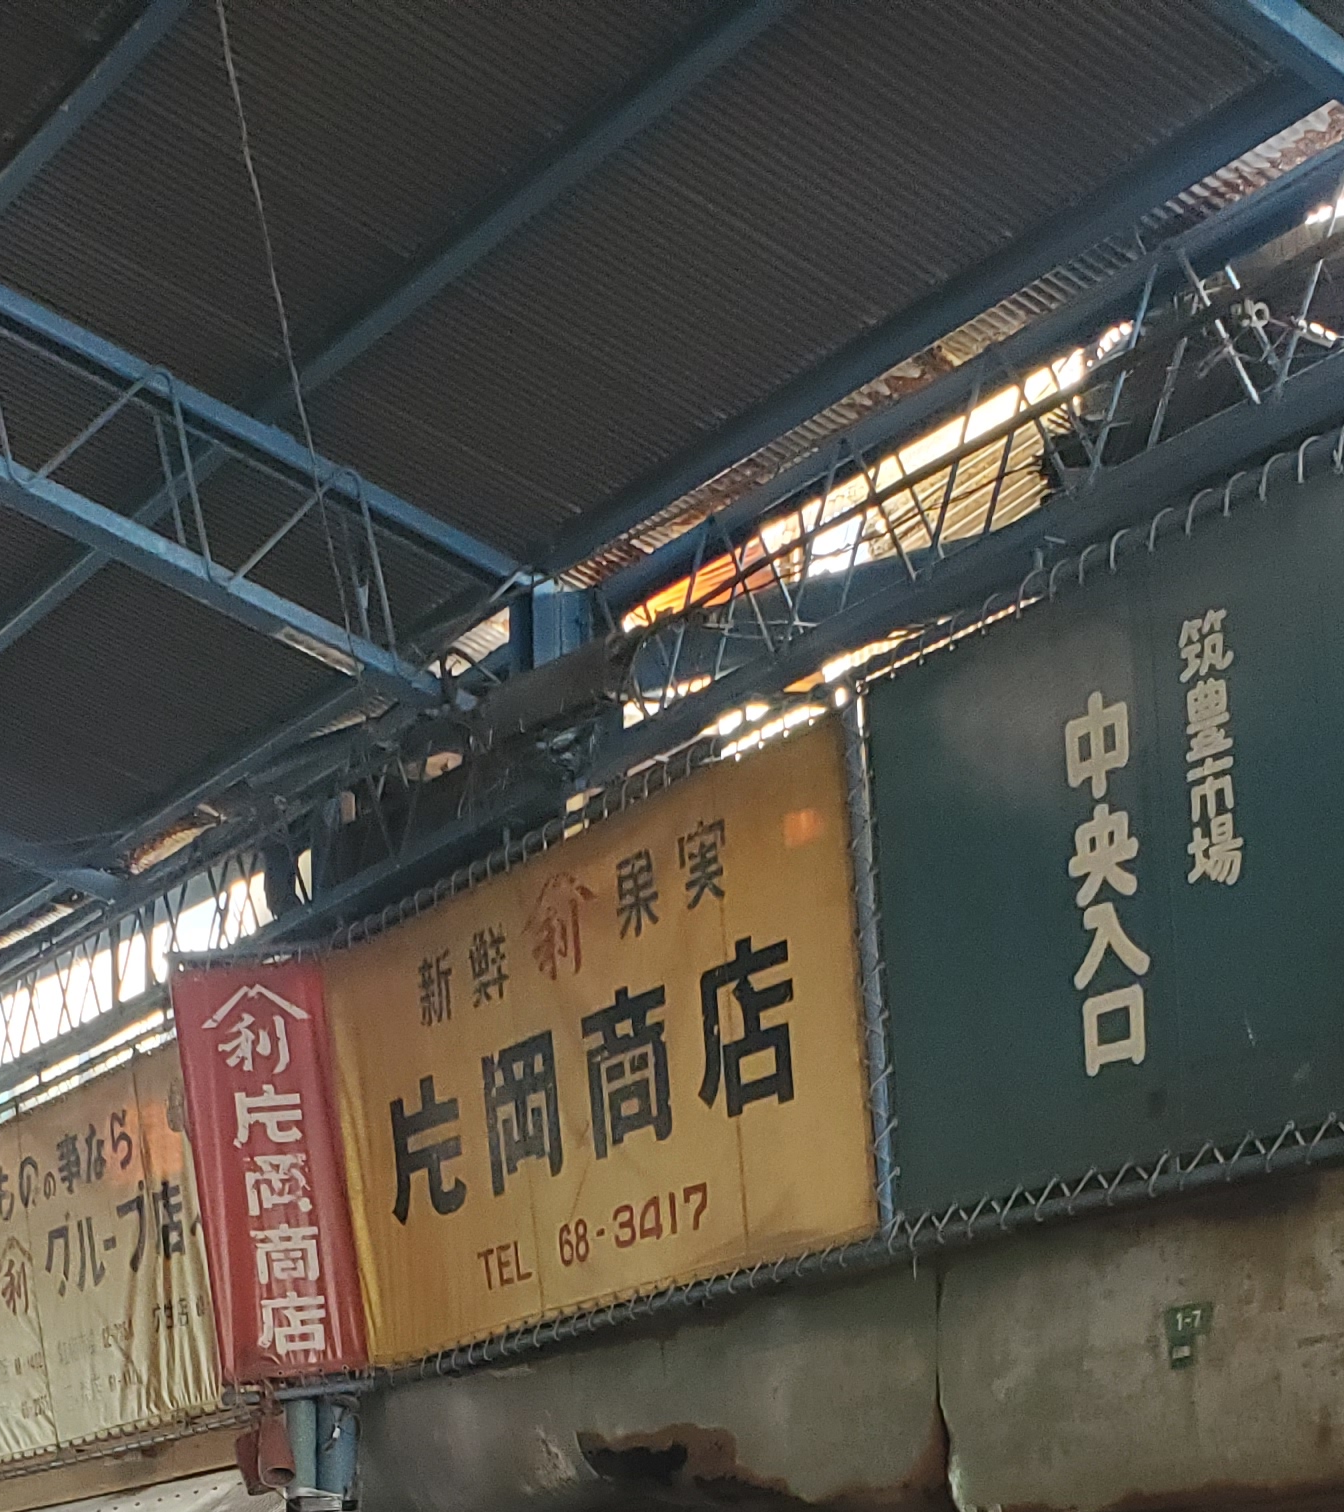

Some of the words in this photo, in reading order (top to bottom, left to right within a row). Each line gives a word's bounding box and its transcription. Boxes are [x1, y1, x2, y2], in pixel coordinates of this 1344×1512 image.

[1065, 691, 1150, 1076] 中央入口
[1178, 609, 1244, 884] 筑豊市場
[389, 936, 795, 1225] 片岡商店
[477, 1241, 533, 1291] TEL
[557, 1181, 708, 1269] 68-3417
[1176, 1310, 1202, 1331] 1-7
